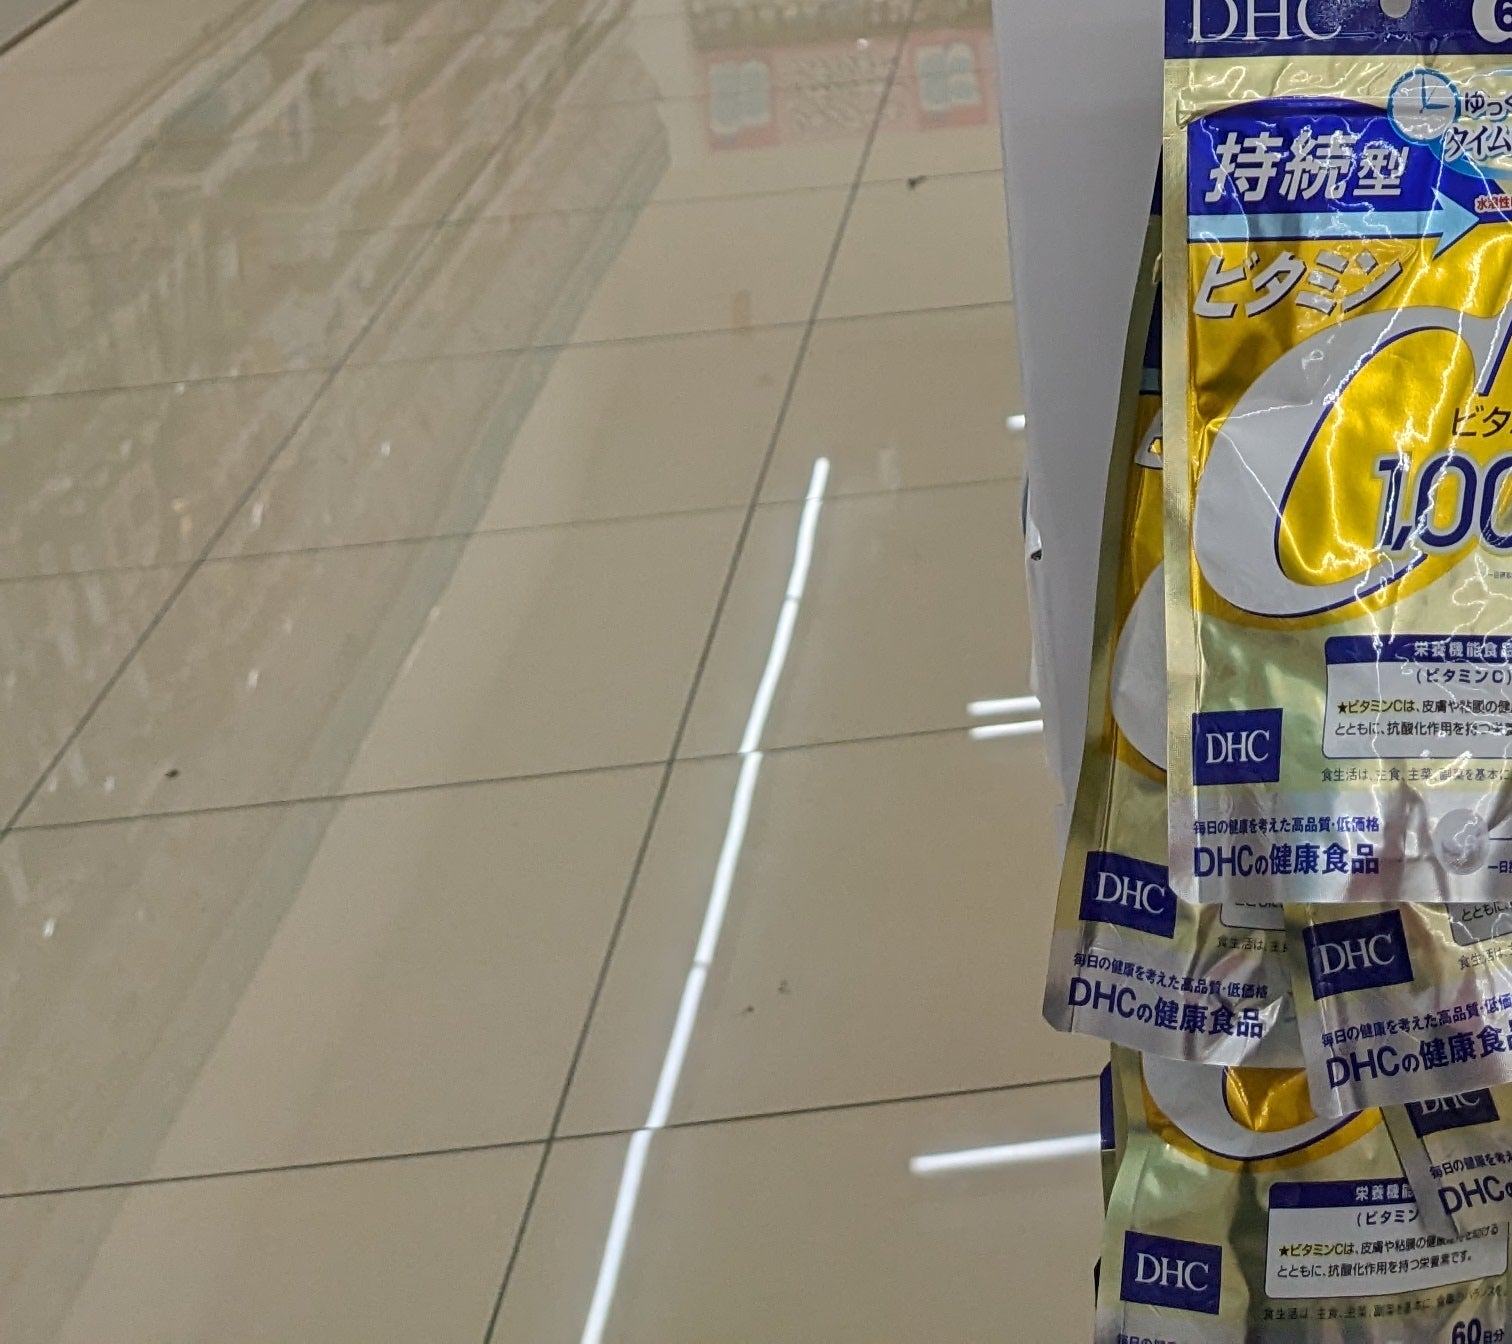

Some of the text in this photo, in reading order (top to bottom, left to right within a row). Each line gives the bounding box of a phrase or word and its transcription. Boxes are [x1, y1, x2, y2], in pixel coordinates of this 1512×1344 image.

[1204, 130, 1411, 203] 持続型
[1191, 248, 1404, 321] ビタミン
[1205, 730, 1270, 765] DHC
[1192, 841, 1381, 879] DHCの健康食品
